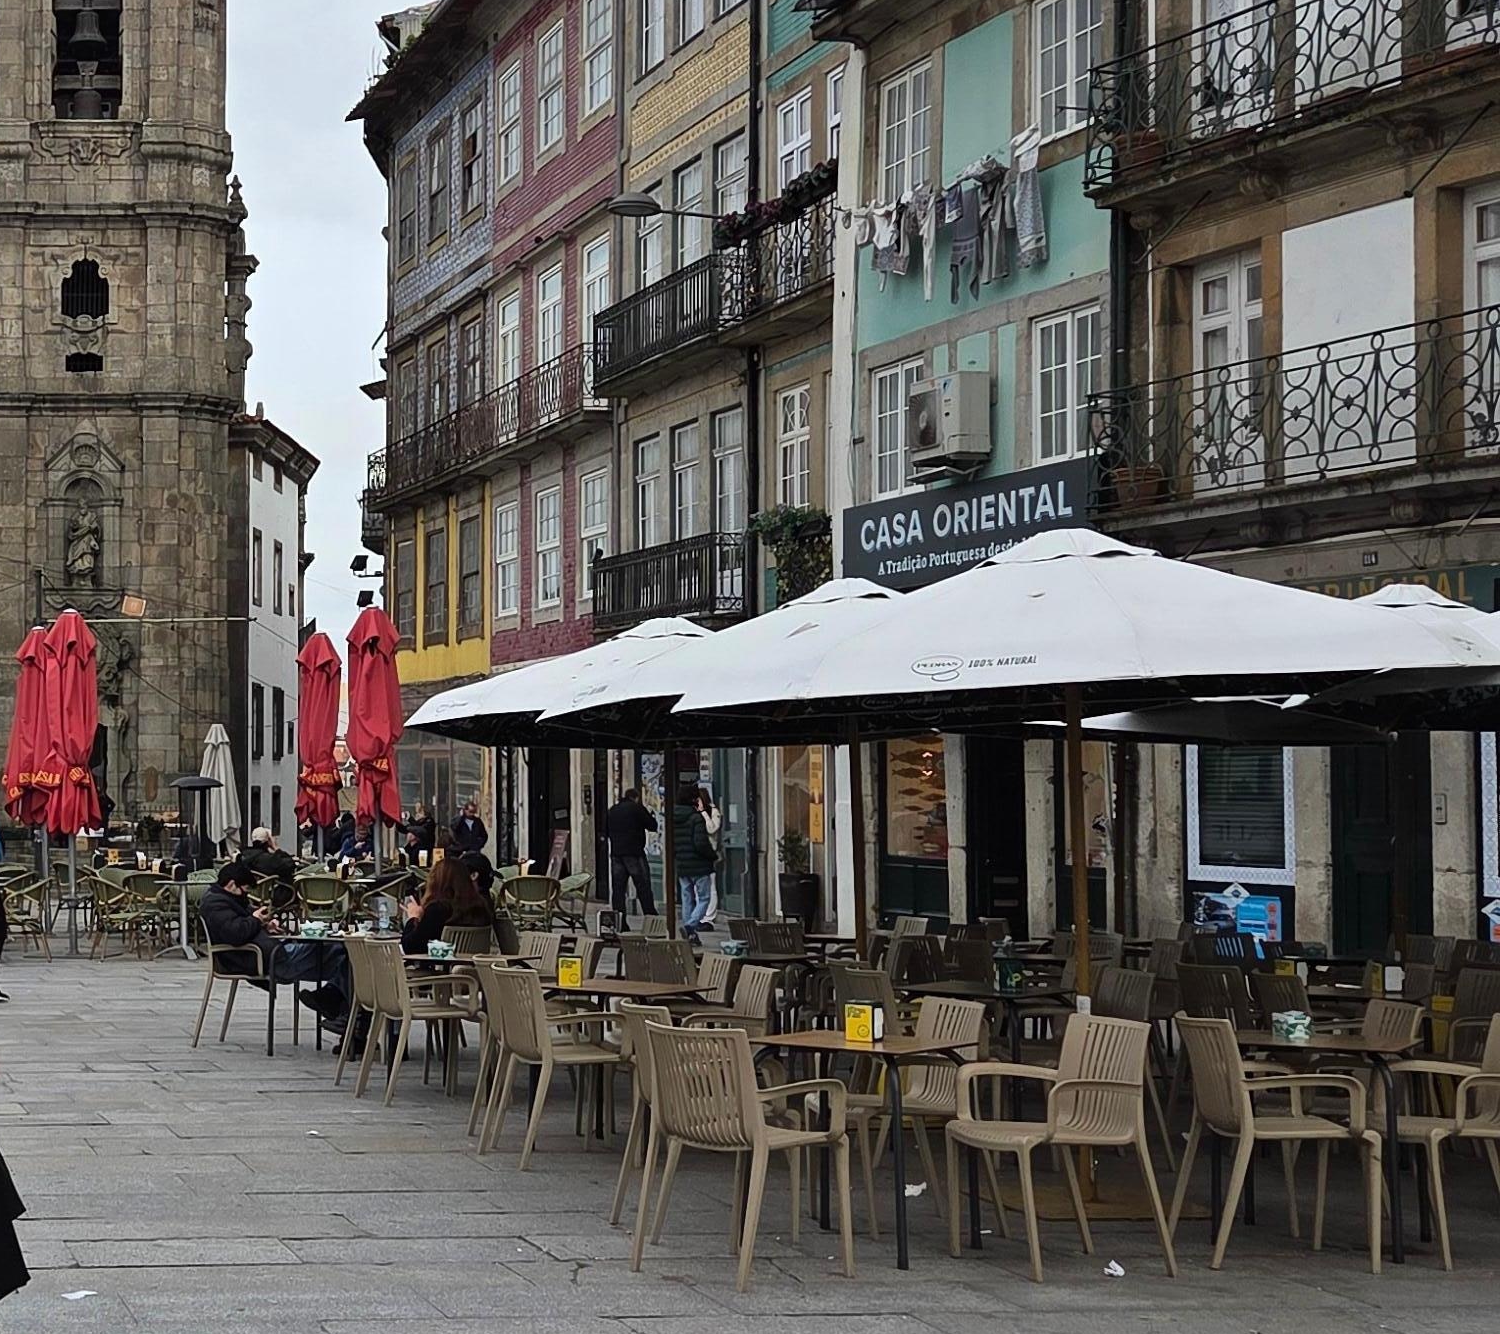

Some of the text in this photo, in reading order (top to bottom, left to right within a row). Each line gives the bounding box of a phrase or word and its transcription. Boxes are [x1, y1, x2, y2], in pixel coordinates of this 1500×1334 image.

[859, 480, 1074, 553] CASA ORIENTAL
[877, 561, 886, 576] A
[886, 554, 928, 574] Tradição
[929, 545, 986, 568] Portuguesa
[967, 658, 995, 668] 100%
[996, 655, 1037, 666] NATURAL
